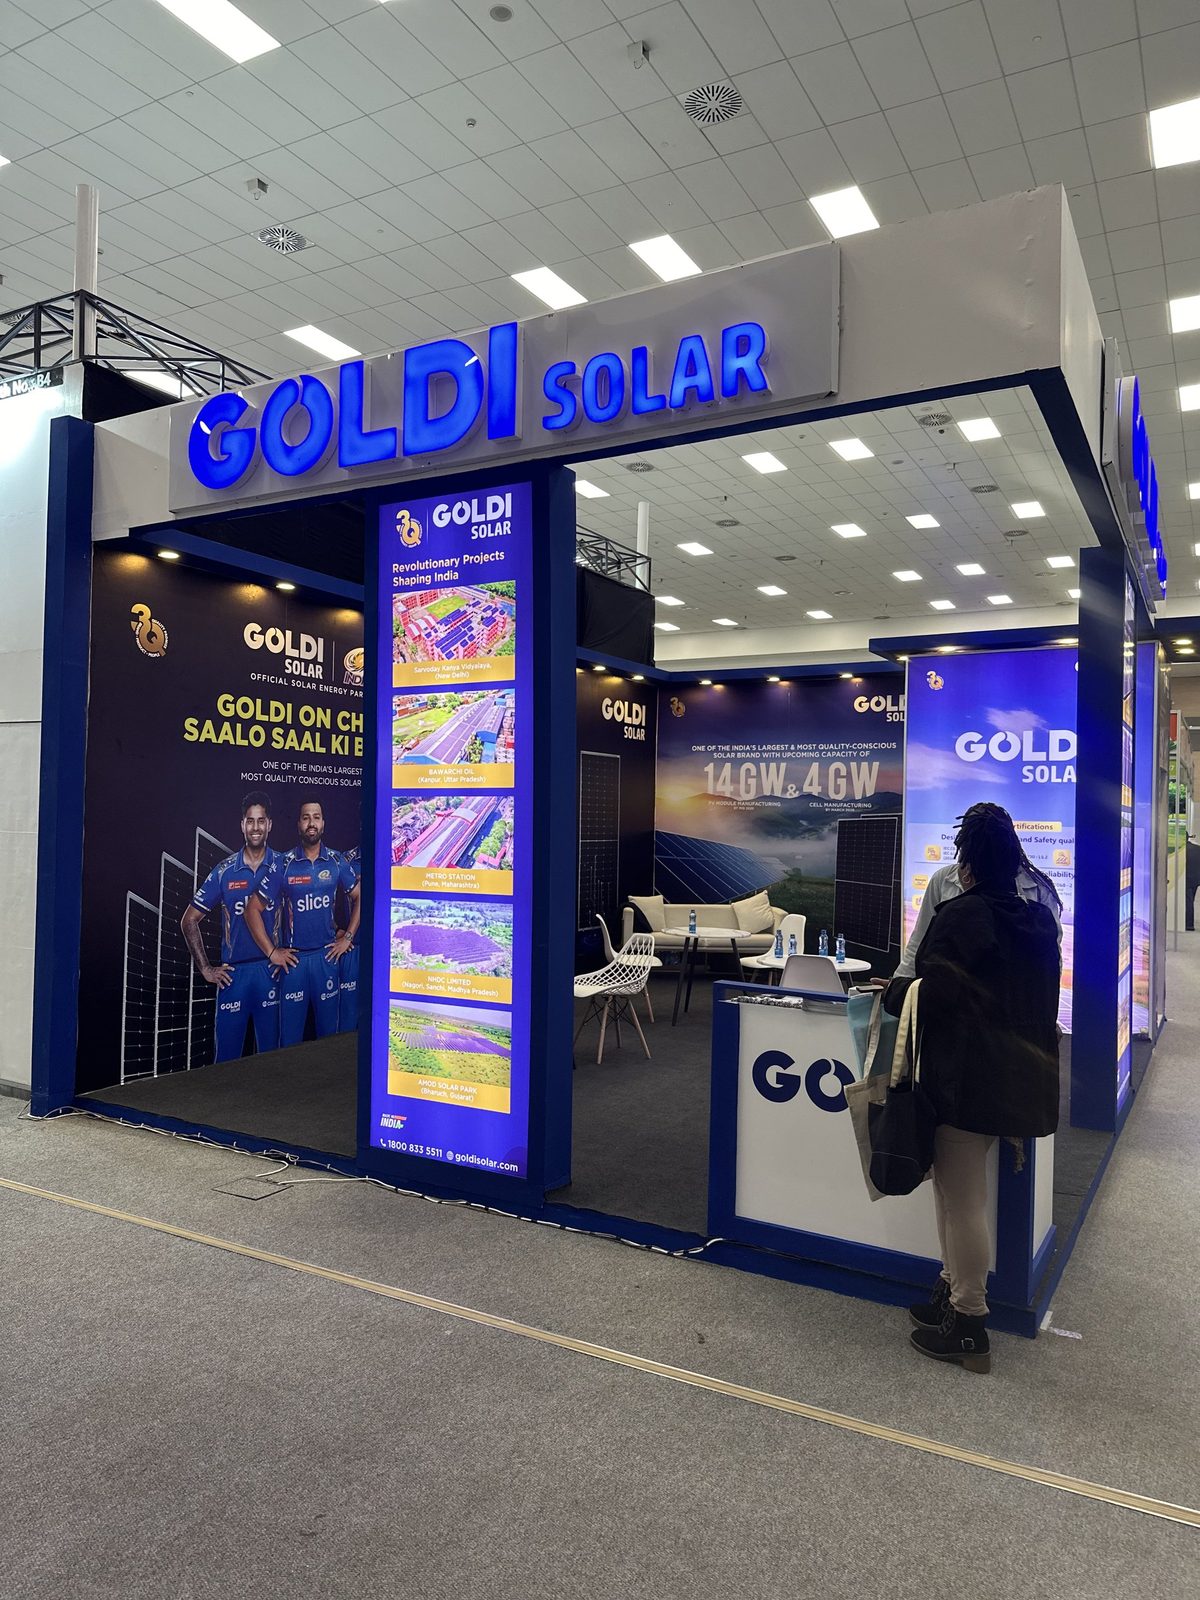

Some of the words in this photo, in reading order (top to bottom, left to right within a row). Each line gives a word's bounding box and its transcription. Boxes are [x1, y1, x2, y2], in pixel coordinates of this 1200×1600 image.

[37, 372, 51, 387] B4
[188, 321, 517, 490] GOLDI
[542, 322, 768, 430] SOLAR
[432, 492, 512, 528] GOLDI
[471, 521, 511, 540] SOLAR
[392, 557, 460, 574] Revolutionary
[463, 551, 505, 565] Projects
[393, 575, 431, 587] Shaping
[434, 571, 458, 582] India
[244, 622, 323, 662] GOLDI
[285, 659, 323, 679] SOLAR
[250, 673, 288, 685] OFFICIAL
[292, 680, 316, 690] SOLAR
[320, 685, 348, 695] ENERGY
[217, 693, 292, 724] GOLDI
[299, 705, 331, 729] ON
[337, 710, 363, 733] CH
[602, 697, 646, 726] GOLDI
[183, 717, 266, 747] SAALO
[270, 727, 326, 753] SAAL
[331, 734, 349, 755] KI
[623, 725, 645, 741] SOLAR
[818, 742, 897, 750] QUALITY-CONSCIOUS
[955, 730, 1076, 762] GOLD
[262, 761, 279, 770] ONE
[281, 762, 291, 771] OF
[293, 763, 307, 772] THE
[308, 764, 333, 773] INDIA'S
[334, 766, 362, 775] LARGEST
[1022, 765, 1076, 783] SOLA
[241, 772, 263, 781] MOST
[265, 774, 297, 783] QUALITY
[298, 775, 339, 786] CONSCIOUS
[340, 778, 362, 787] SOLAR
[786, 784, 799, 798] &
[1034, 837, 1057, 845] Safety
[297, 893, 330, 912] slice
[285, 991, 304, 1000] GOLDI
[220, 1001, 240, 1010] GOLDI
[437, 1082, 459, 1091] SOLAR
[460, 1085, 477, 1094] PARK
[380, 1117, 401, 1129] INDIA
[388, 1140, 407, 1150] 1800
[409, 1144, 424, 1154] 833
[426, 1147, 443, 1157] 5511
[455, 1152, 518, 1172] goldisolar.com
